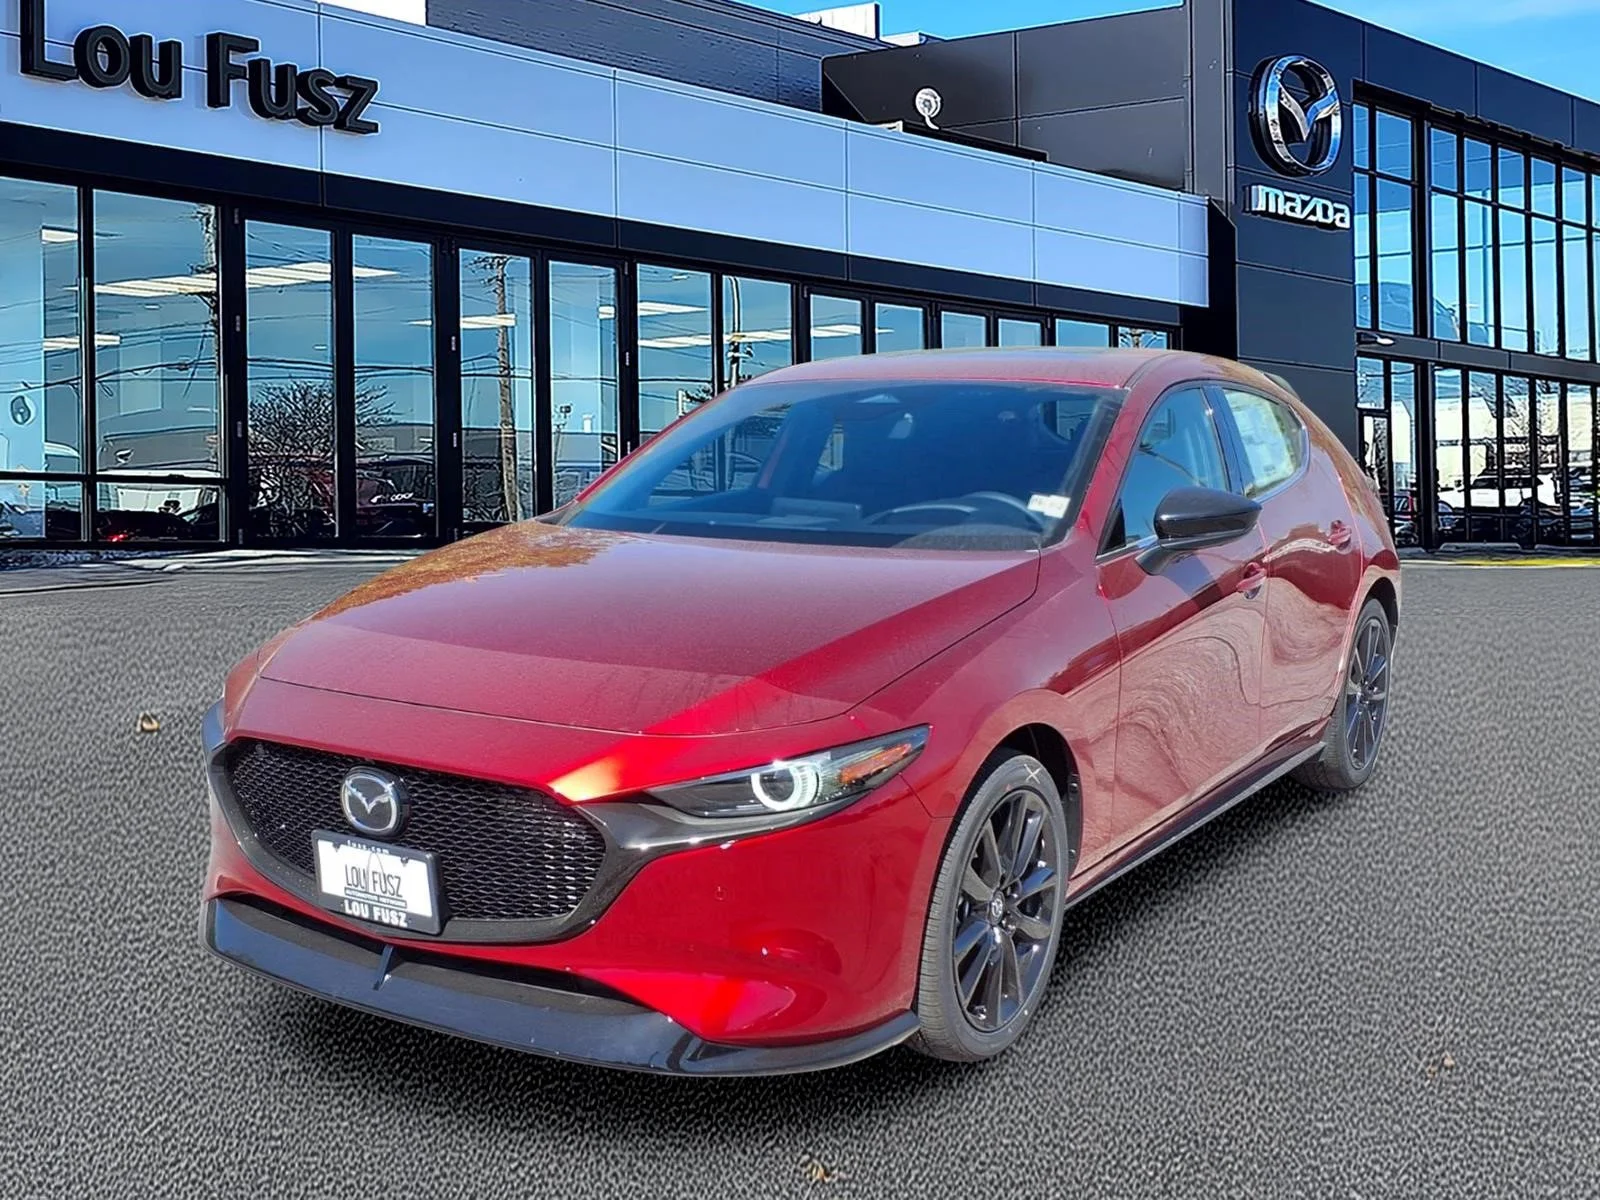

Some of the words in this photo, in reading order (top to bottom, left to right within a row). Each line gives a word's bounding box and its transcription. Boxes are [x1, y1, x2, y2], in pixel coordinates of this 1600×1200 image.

[20, 0, 183, 101] Lou
[206, 31, 380, 135] Fusz
[345, 863, 367, 890] LOU
[371, 870, 403, 898] FUSZ
[344, 899, 370, 917] LOU
[373, 906, 408, 928] FUSZ
